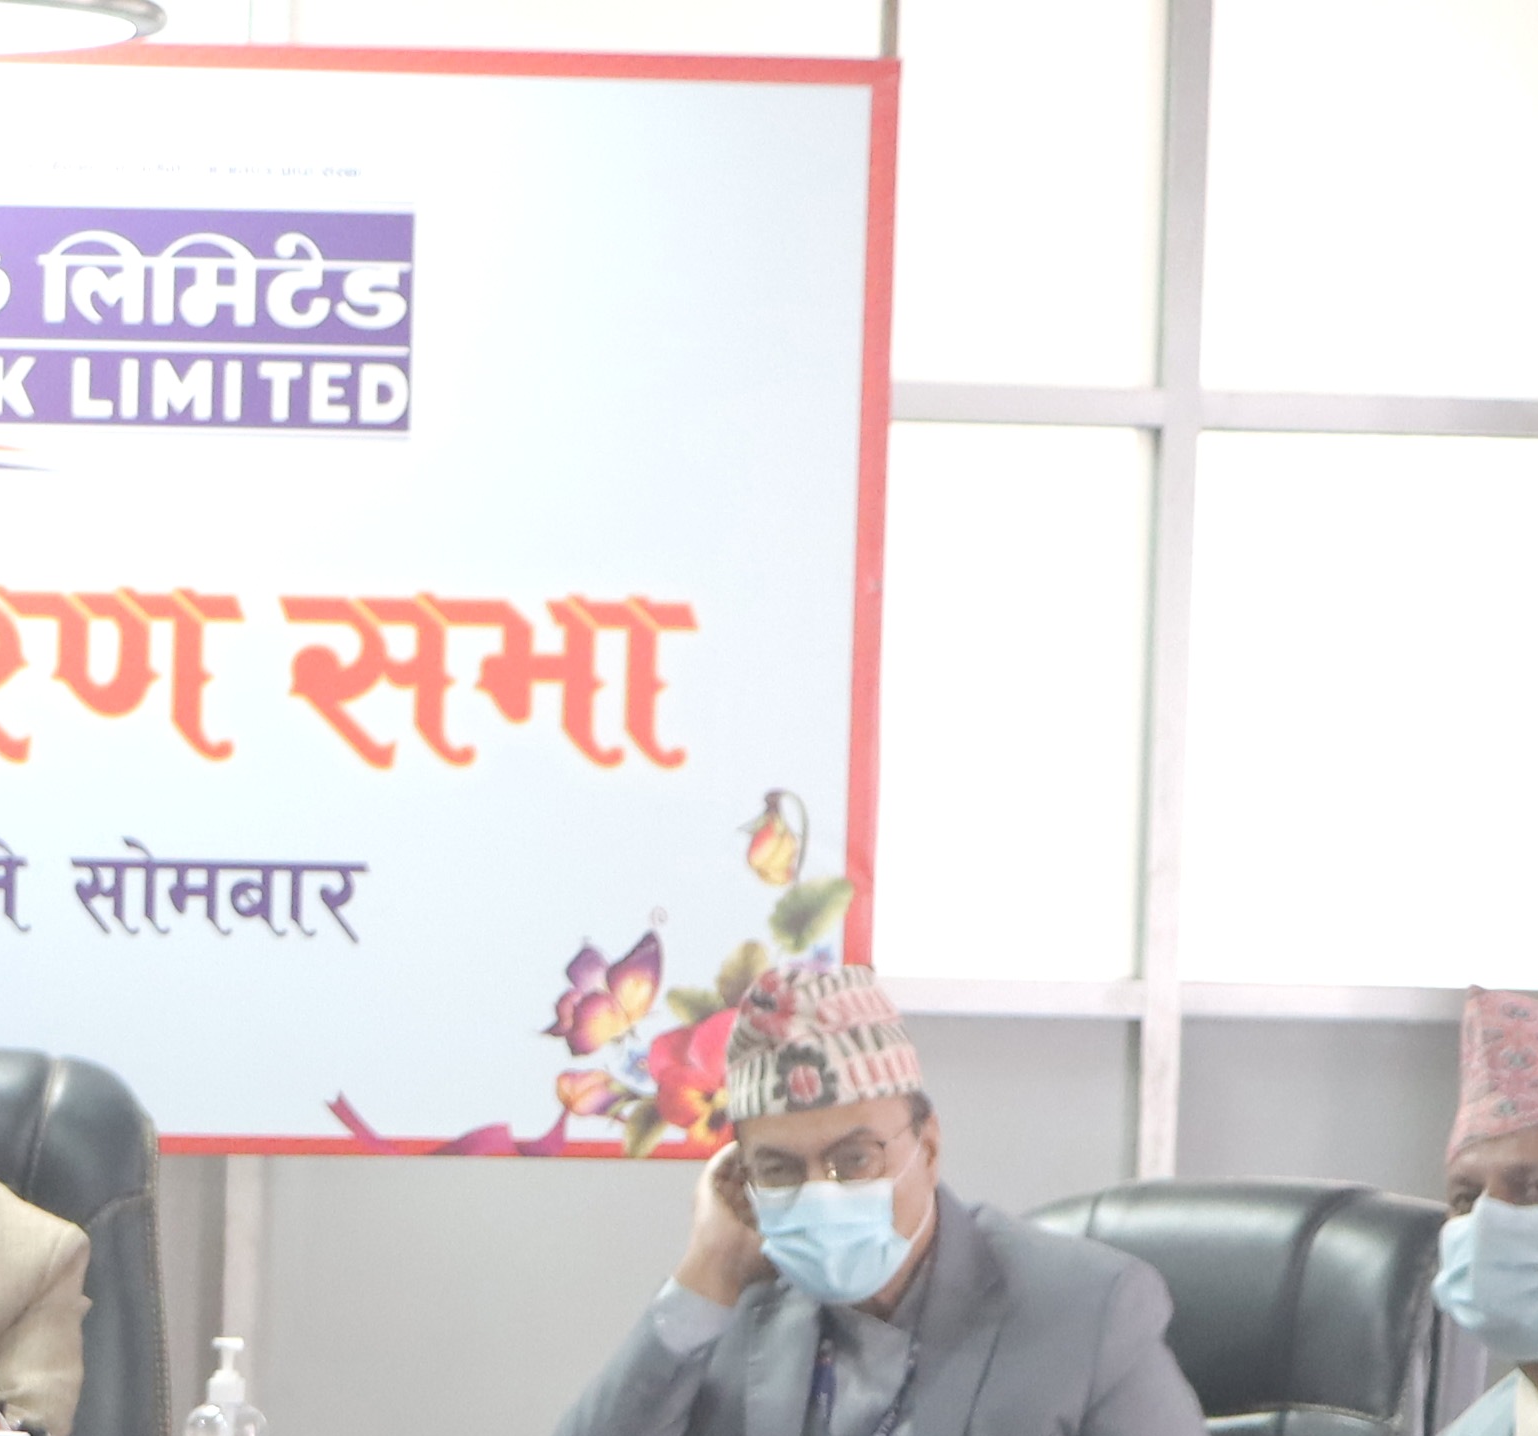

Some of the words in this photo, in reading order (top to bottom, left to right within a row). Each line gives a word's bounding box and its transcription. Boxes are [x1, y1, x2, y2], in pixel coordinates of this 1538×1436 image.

[35, 230, 412, 331] लिमिटेड
[71, 357, 410, 424] LIMITED
[279, 592, 698, 770] सभा
[71, 836, 368, 943] सोमबार
